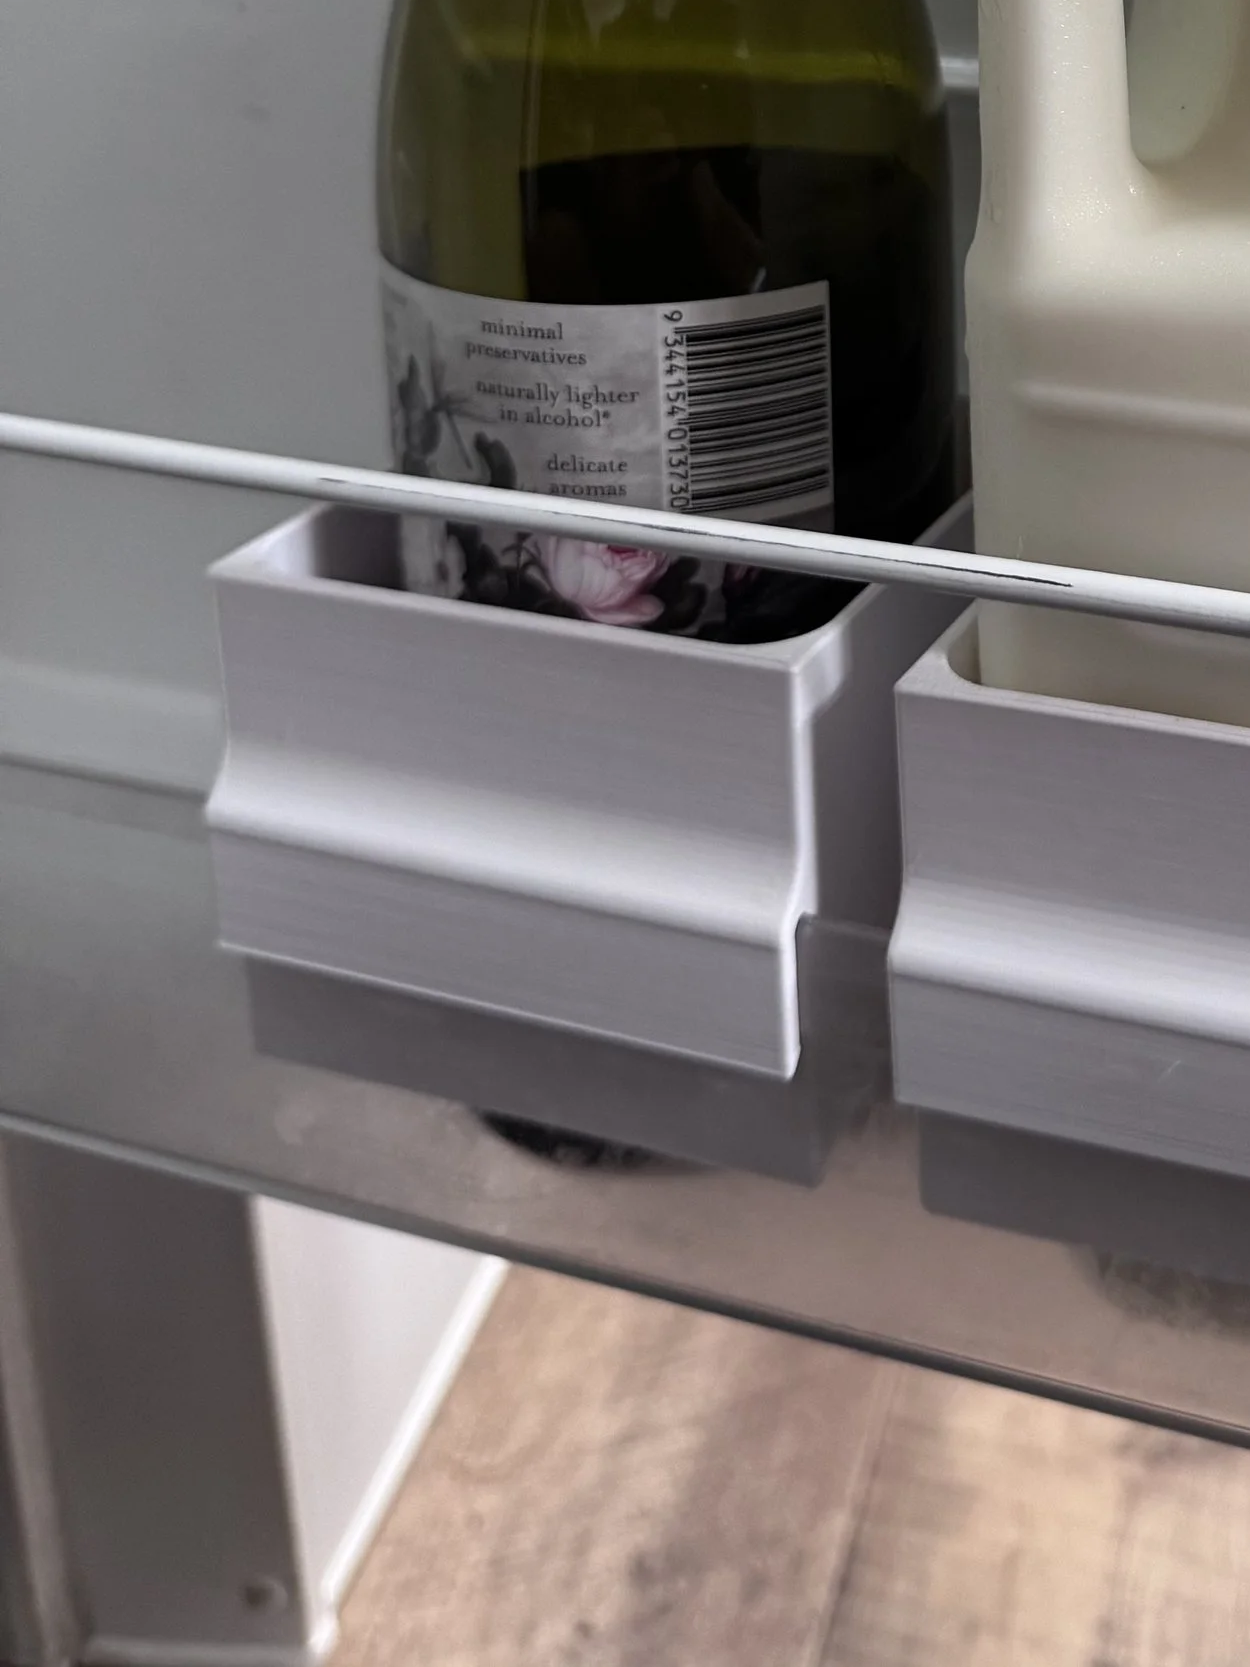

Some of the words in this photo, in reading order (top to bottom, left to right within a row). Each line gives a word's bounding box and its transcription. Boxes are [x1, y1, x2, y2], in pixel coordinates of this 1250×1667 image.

[663, 309, 684, 323] 9
[480, 319, 564, 340] minimal
[464, 341, 588, 366] preservatives
[476, 380, 560, 408] naturally
[565, 384, 641, 410] lighter
[500, 404, 519, 423] in
[547, 453, 628, 473] delicate
[550, 484, 628, 497] aromas
